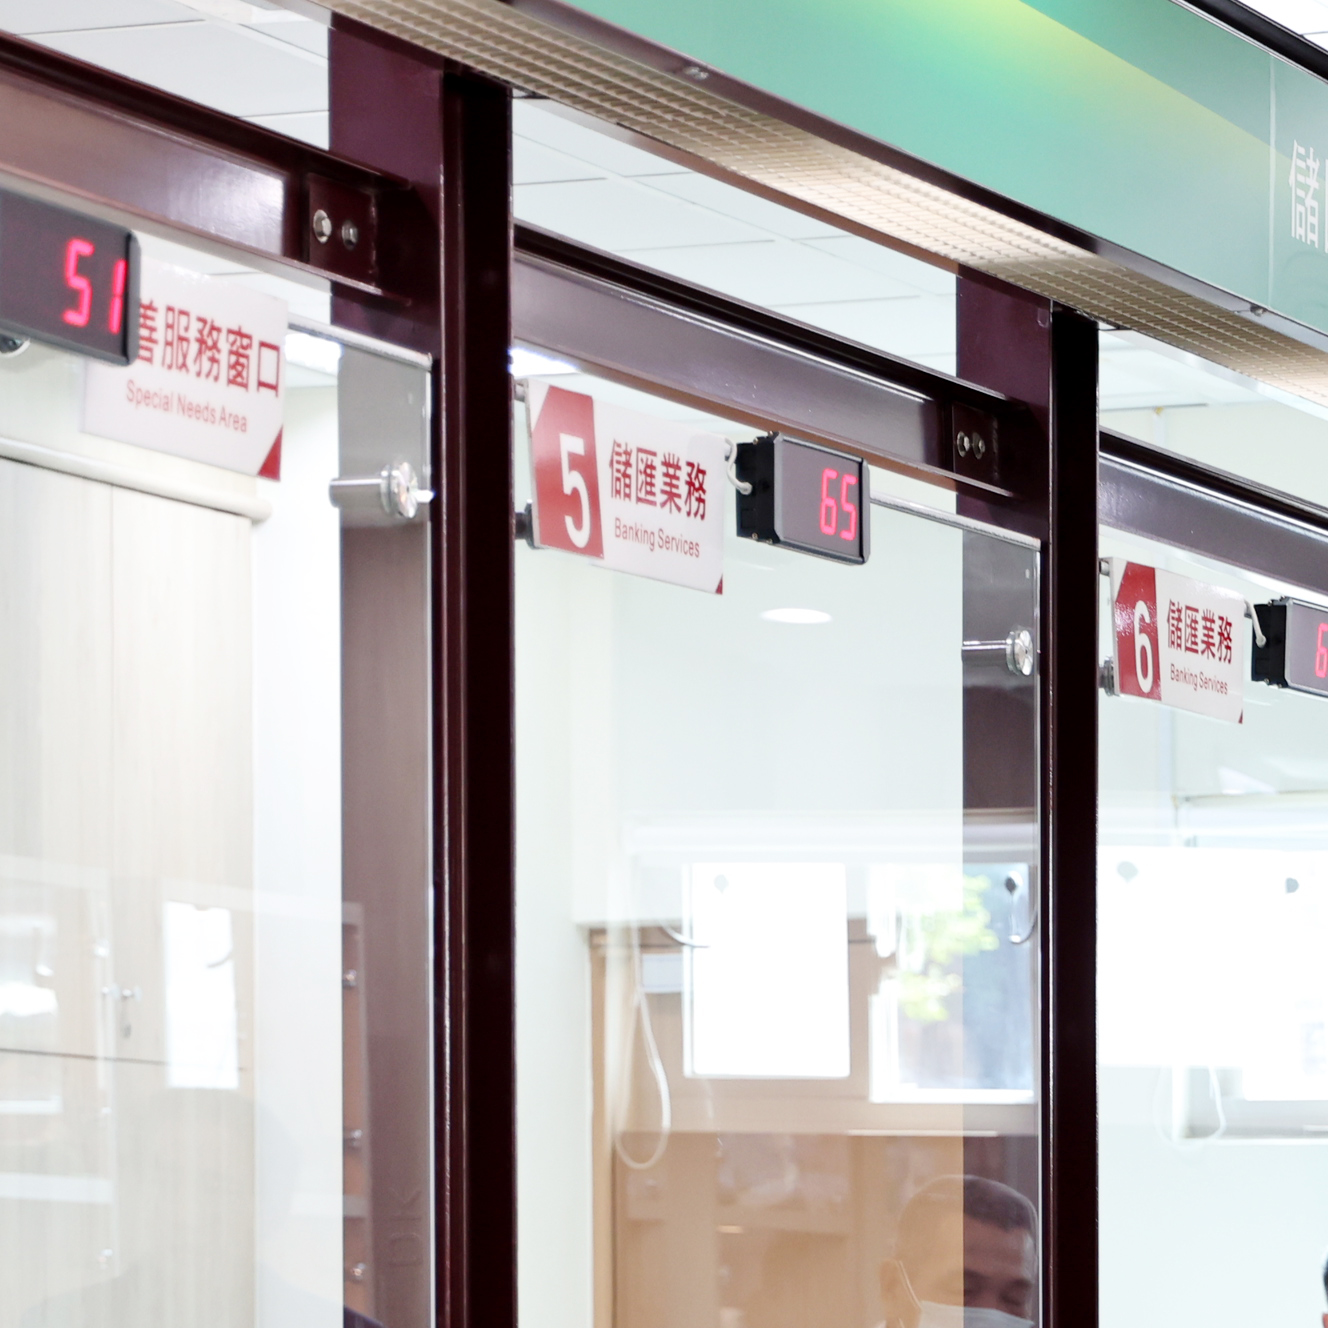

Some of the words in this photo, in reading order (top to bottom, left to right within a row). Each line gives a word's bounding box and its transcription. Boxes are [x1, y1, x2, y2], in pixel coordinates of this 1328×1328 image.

[63, 238, 129, 335] 51
[126, 379, 173, 412] Special
[177, 393, 217, 425] Needs
[219, 404, 247, 433] Area
[558, 432, 591, 549] 5
[608, 438, 707, 521] 儲匯業務
[818, 467, 859, 542] 65
[614, 518, 655, 553] Banking
[657, 527, 701, 559] Services
[1133, 600, 1154, 694] 6
[1166, 598, 1233, 665] 儲匯業務
[1170, 663, 1198, 690] Banking
[1198, 671, 1228, 695] Services
